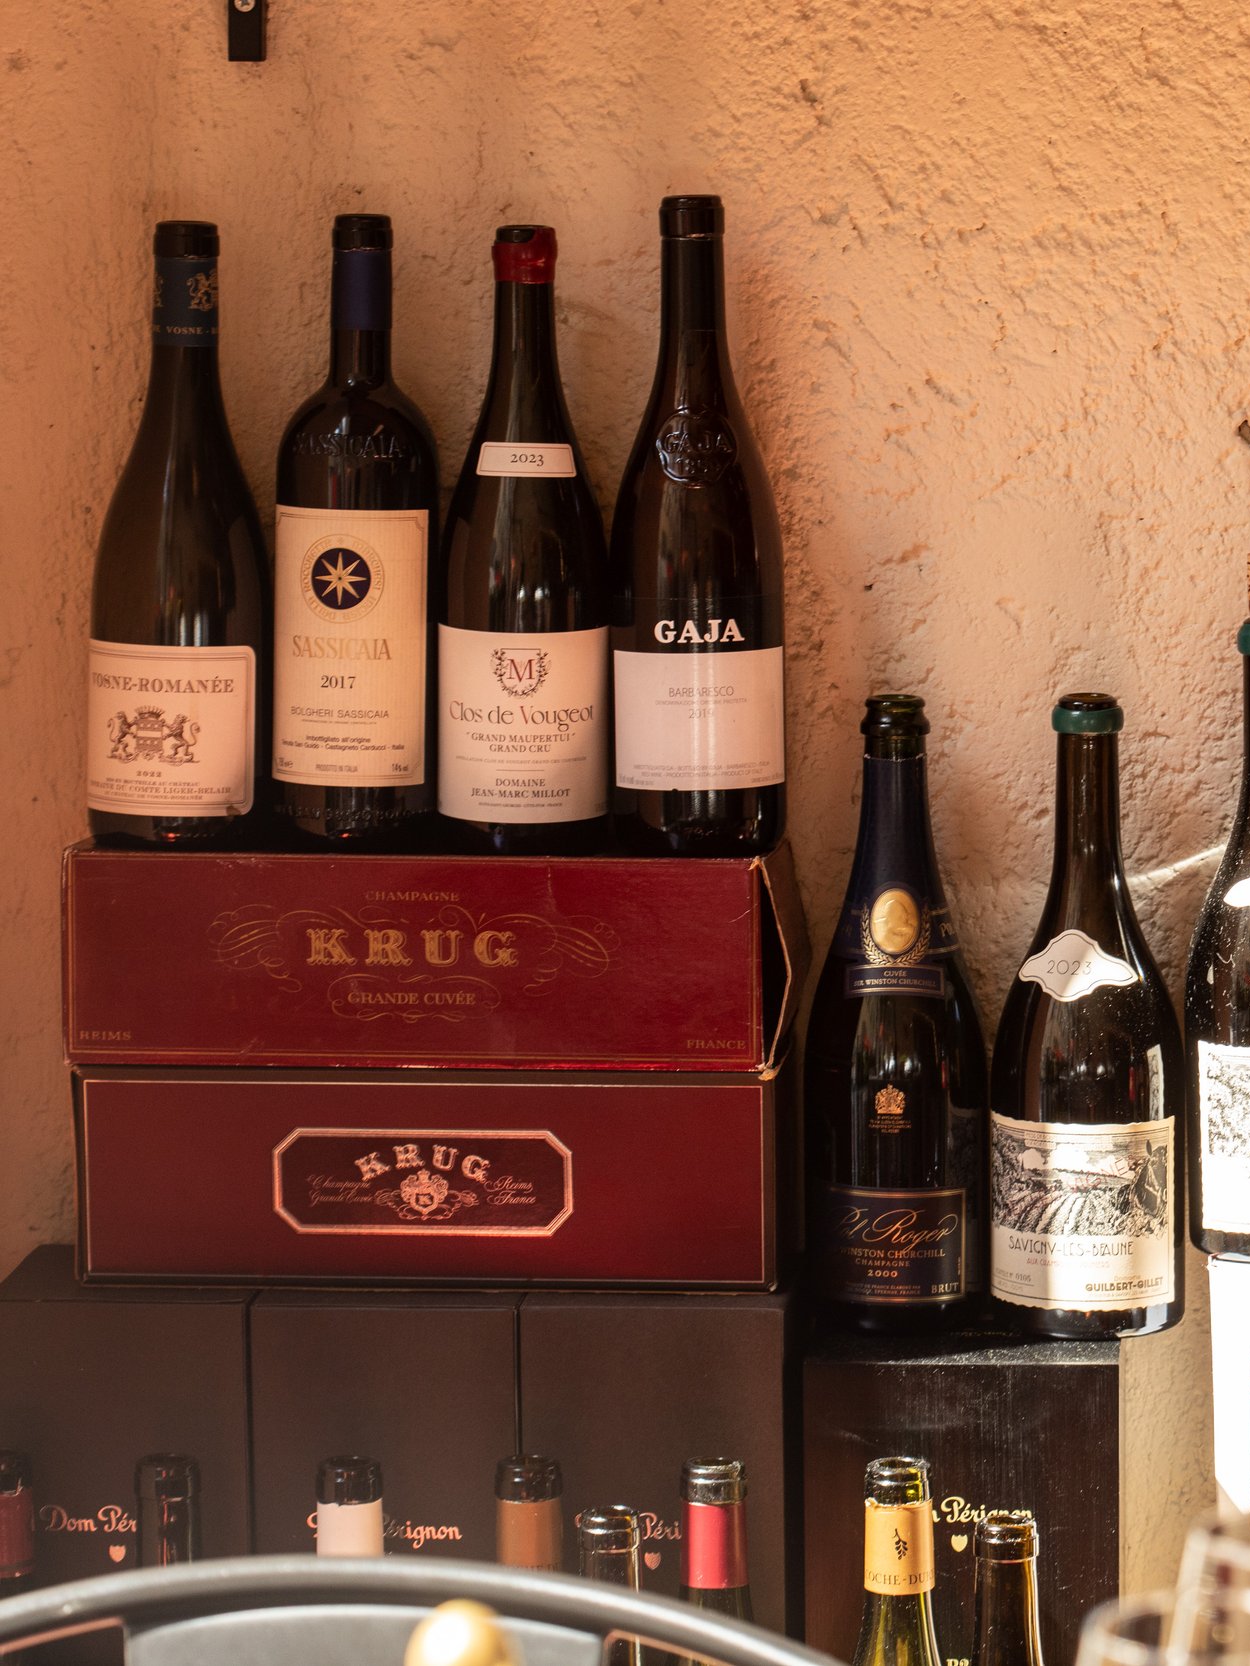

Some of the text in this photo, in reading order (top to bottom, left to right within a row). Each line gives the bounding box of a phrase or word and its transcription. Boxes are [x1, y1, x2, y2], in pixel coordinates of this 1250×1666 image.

[509, 452, 545, 467] 2023
[653, 618, 745, 644] GAJA
[292, 634, 392, 661] SASSICAIA
[320, 674, 357, 689] 2017
[668, 685, 735, 698] BARBARESCO
[290, 705, 390, 719] BOLGHERI SASSICAIA
[449, 700, 595, 733] Clos de Vougeot
[489, 743, 552, 753] GRAND CRU
[136, 770, 162, 778] 2022
[495, 778, 546, 788] DOMAINE
[470, 787, 571, 799] JEAN-MARC MILLOT
[364, 889, 460, 903] CHAMPAGNE
[305, 928, 520, 968] KRUG
[1046, 957, 1093, 977] 2023
[865, 978, 898, 986] WINSTON
[347, 988, 477, 1006] GRANDE CUVÉE
[79, 1029, 132, 1042] REIMS
[685, 1037, 747, 1051] FRANCE
[353, 1143, 491, 1184] KRUG
[862, 1208, 959, 1253] Roger
[887, 1248, 946, 1259] CHURCHILL
[855, 1258, 911, 1268] CHAMPAGNE
[867, 1269, 899, 1279] 2000
[931, 1282, 960, 1295] BRUT
[1085, 1276, 1164, 1292] GUILBERT-GILLET
[39, 1504, 97, 1533] Dom
